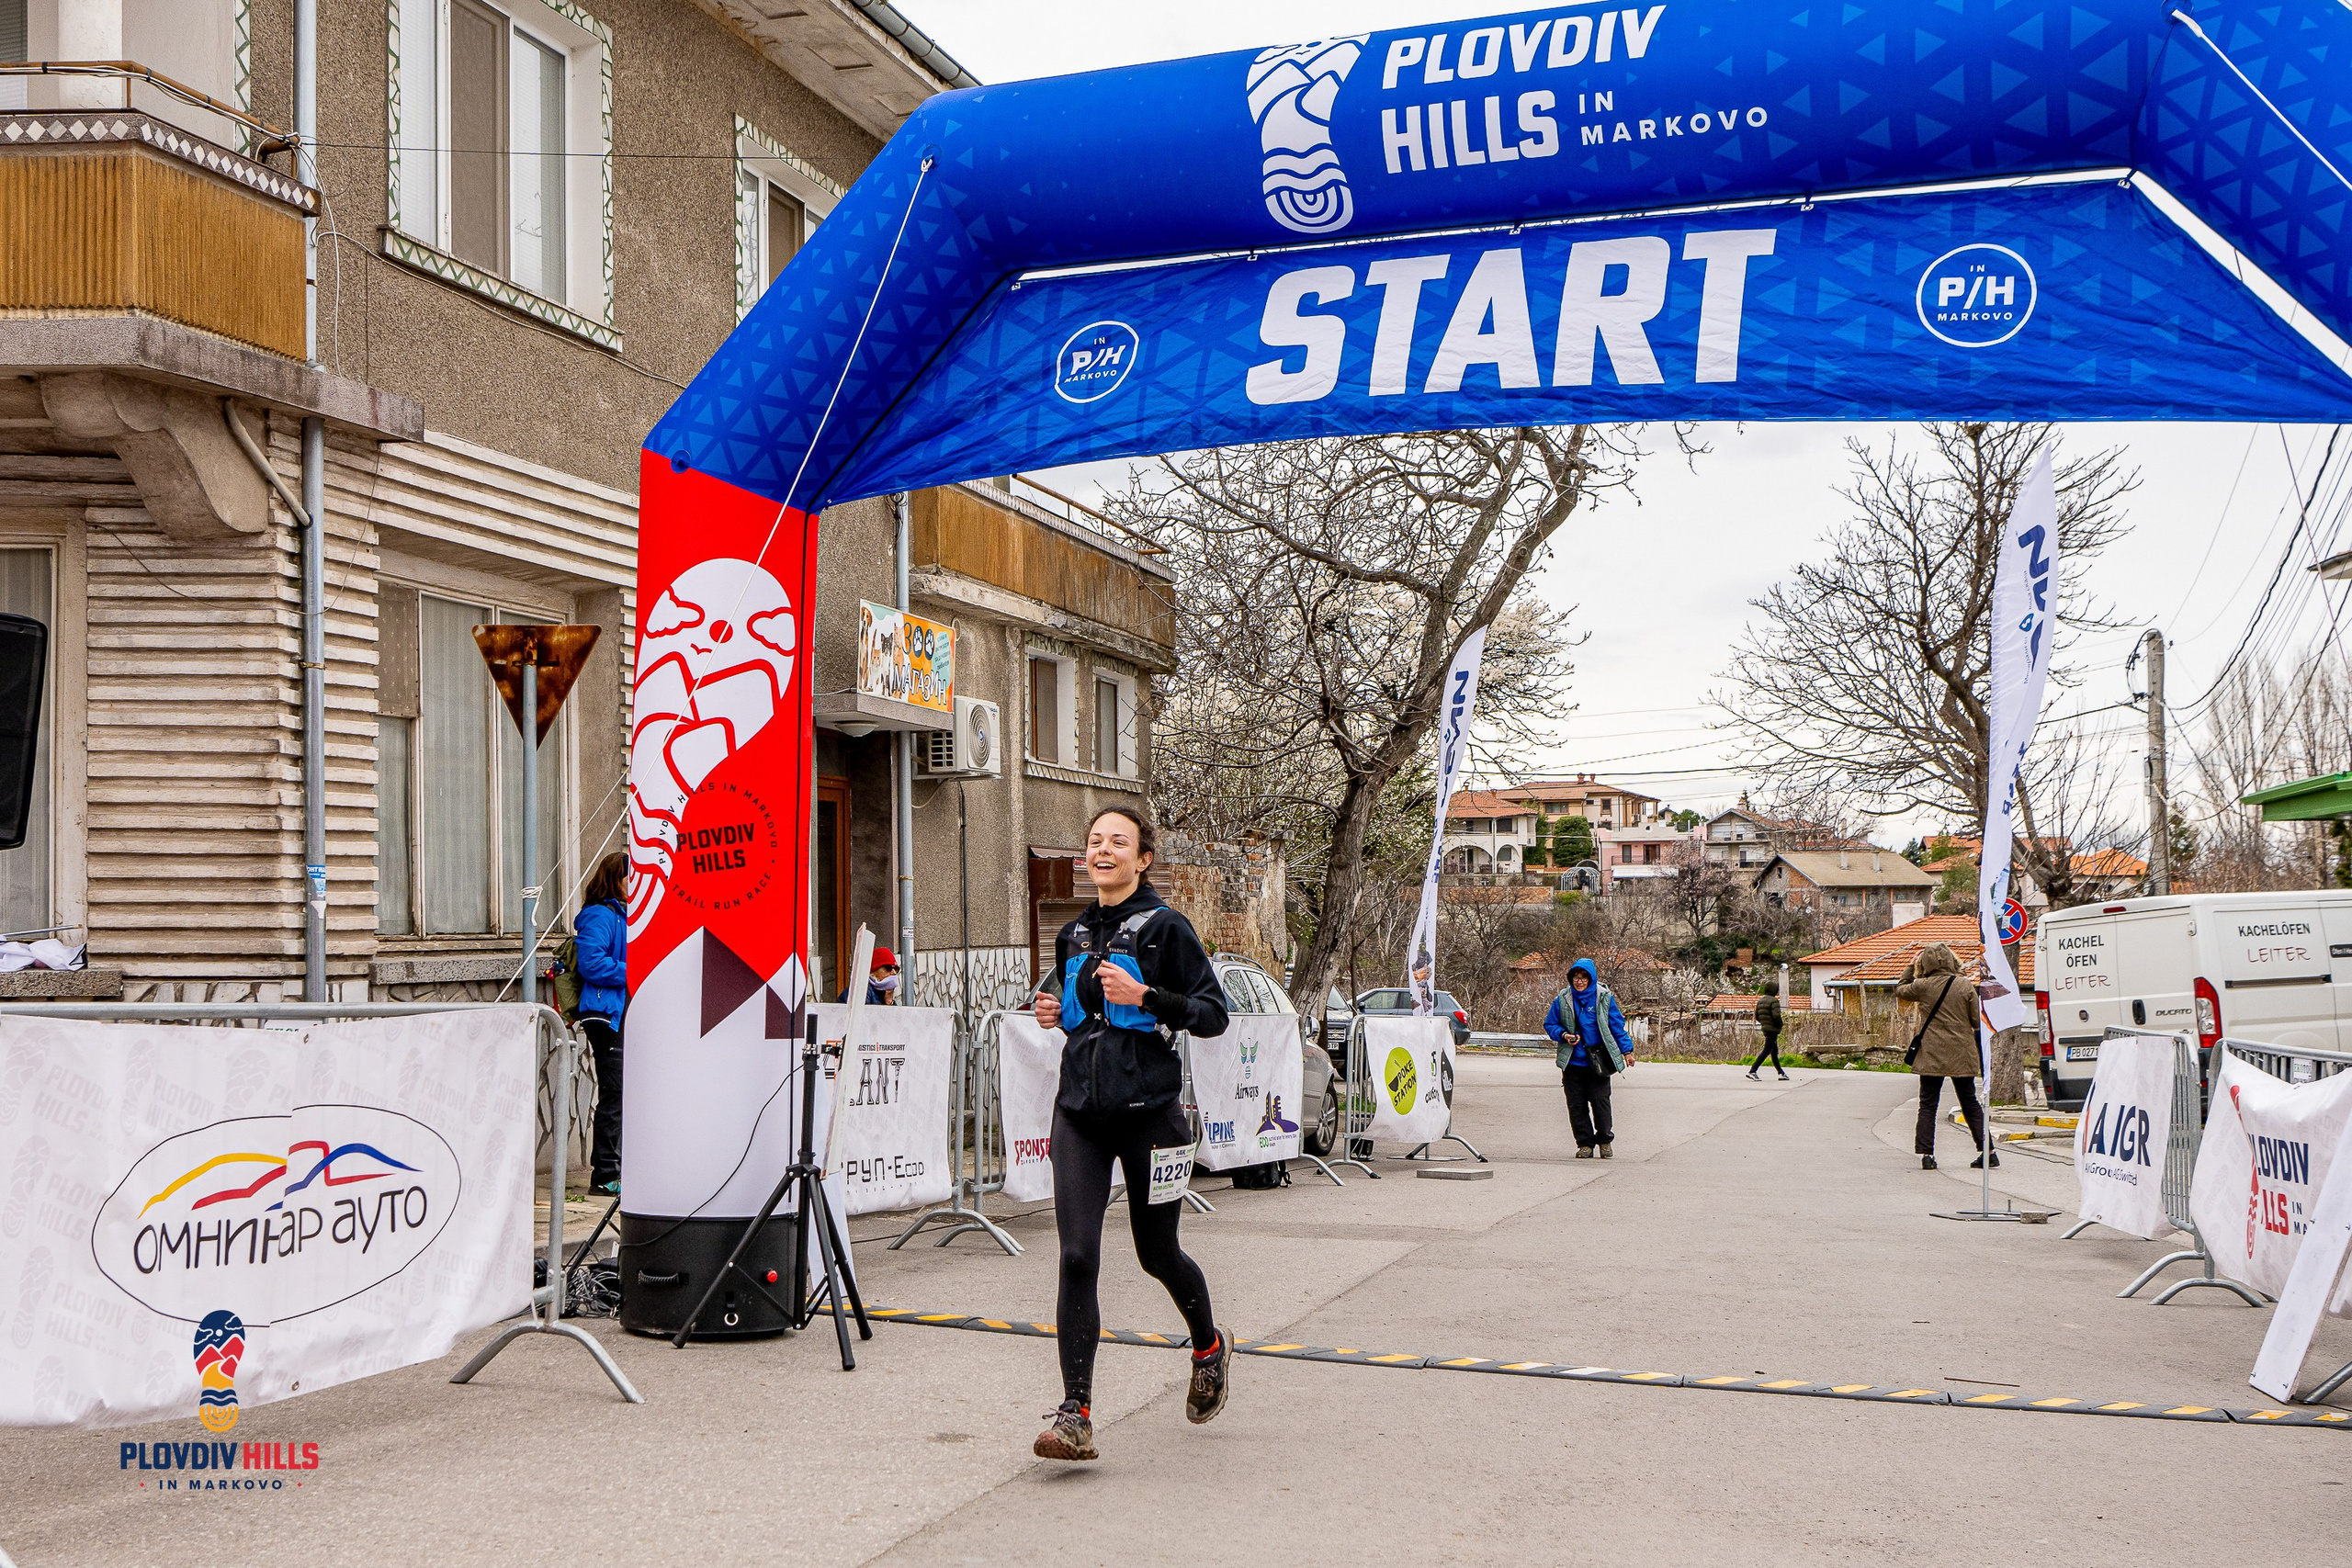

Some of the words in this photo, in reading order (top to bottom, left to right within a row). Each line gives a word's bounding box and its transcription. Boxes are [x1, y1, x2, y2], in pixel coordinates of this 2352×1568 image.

[1382, 5, 1668, 90] PLOVDIV
[1578, 91, 1614, 114] IN
[1381, 90, 1560, 175] HILLS
[1580, 107, 1769, 146] MARKOVO
[1969, 264, 1985, 273] IN
[1246, 228, 1776, 406] START
[1937, 311, 2014, 321] MARKOVO
[1093, 336, 1106, 345] IN
[1064, 369, 1117, 384] MARKOVO
[892, 661, 948, 706] МАГАЗИН
[658, 805, 675, 865] PLOVDIV
[677, 782, 715, 804] HILLS
[723, 783, 738, 794] IN
[742, 790, 778, 849] MARKOVO
[676, 822, 755, 853] PLOVDIV
[692, 849, 746, 874] HILLS
[672, 884, 707, 909] TRAIL
[714, 898, 741, 911] RUN
[746, 872, 772, 901] RACE
[2238, 921, 2311, 937] KACHELÖFEN
[2058, 934, 2105, 951] KACHEL
[2066, 953, 2098, 968] ÖFEN
[2247, 946, 2312, 963] LEITER
[2055, 975, 2110, 990] LEITER
[2155, 1009, 2193, 1017] DUCATO
[879, 1043, 906, 1052] TRANSPORT
[1396, 1059, 1414, 1082] POKE
[1235, 1084, 1260, 1101] Airways
[1394, 1073, 1417, 1107] STATION
[1152, 1159, 1192, 1184] 4220
[2292, 1201, 2302, 1215] IN
